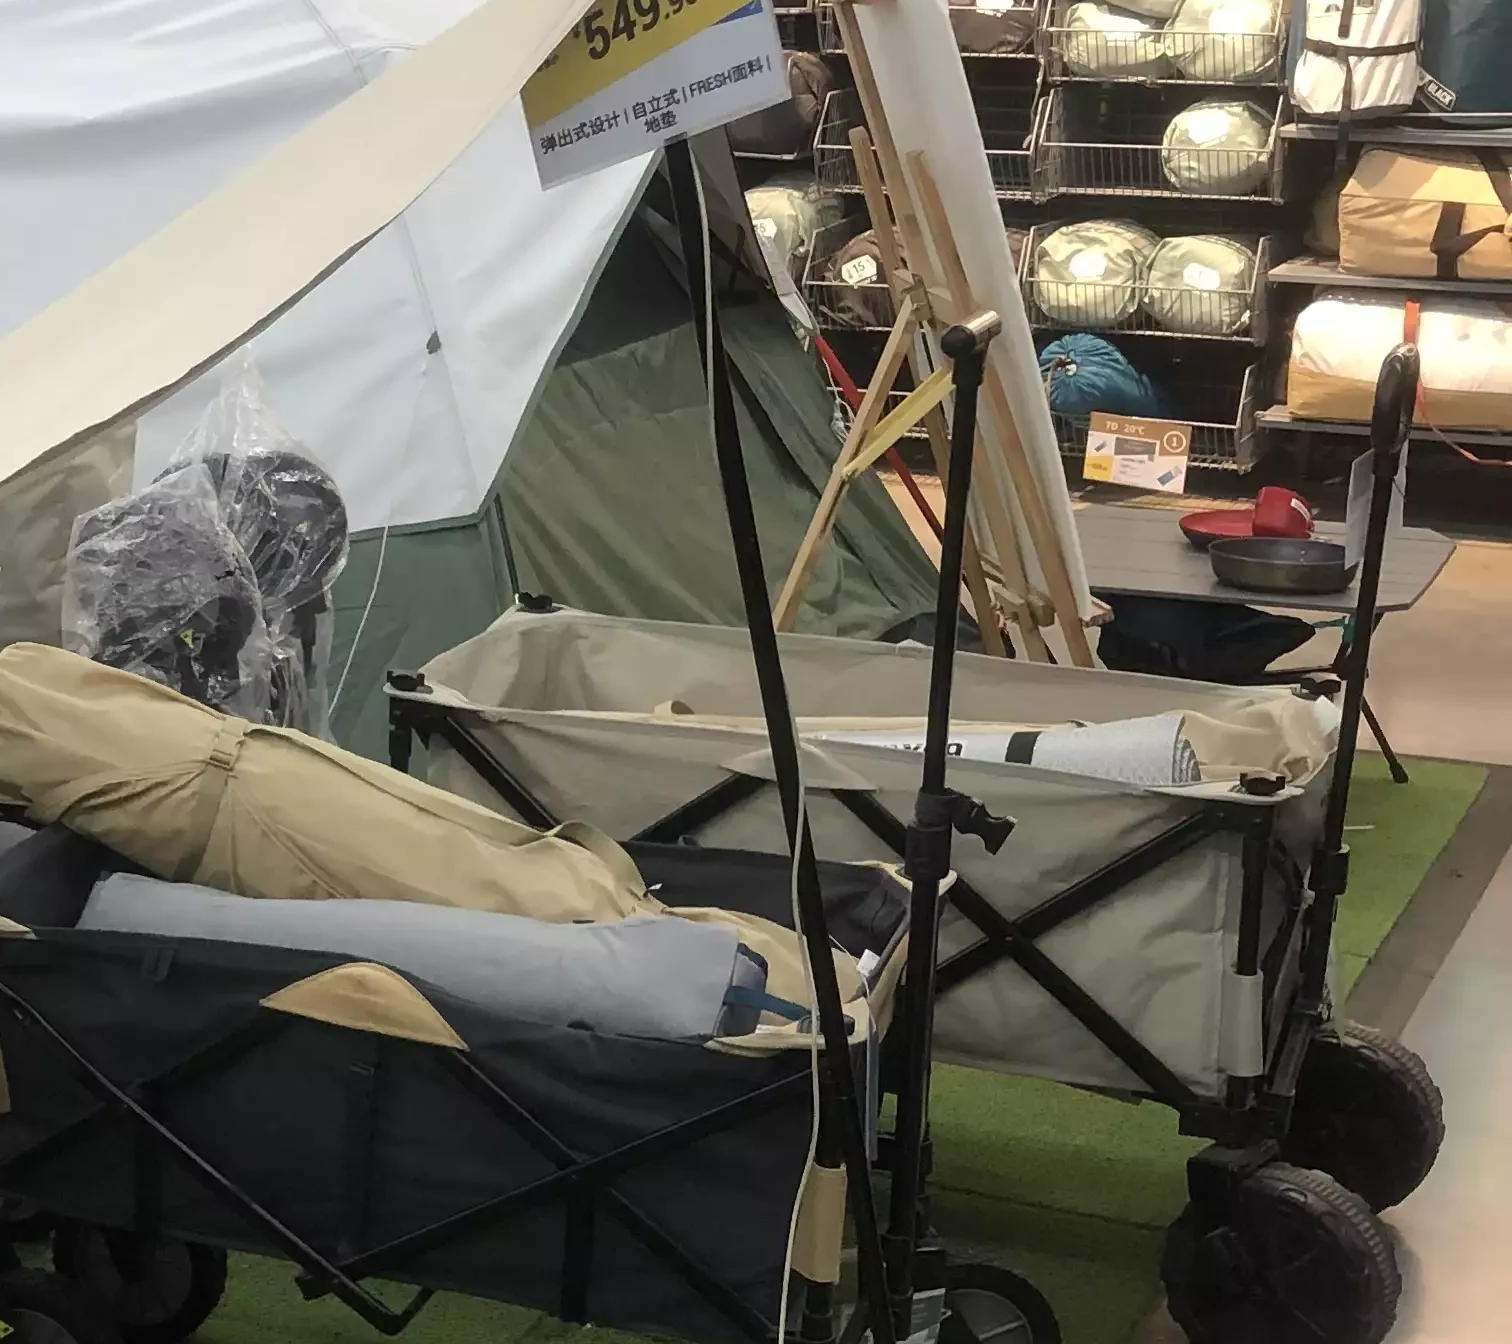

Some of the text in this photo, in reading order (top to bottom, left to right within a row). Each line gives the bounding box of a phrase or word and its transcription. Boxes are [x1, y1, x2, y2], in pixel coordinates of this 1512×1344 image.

[540, 56, 764, 155] 弹出式设计 自立式 FRESH面料
[644, 111, 677, 134] 地垫
[852, 261, 866, 274] 15
